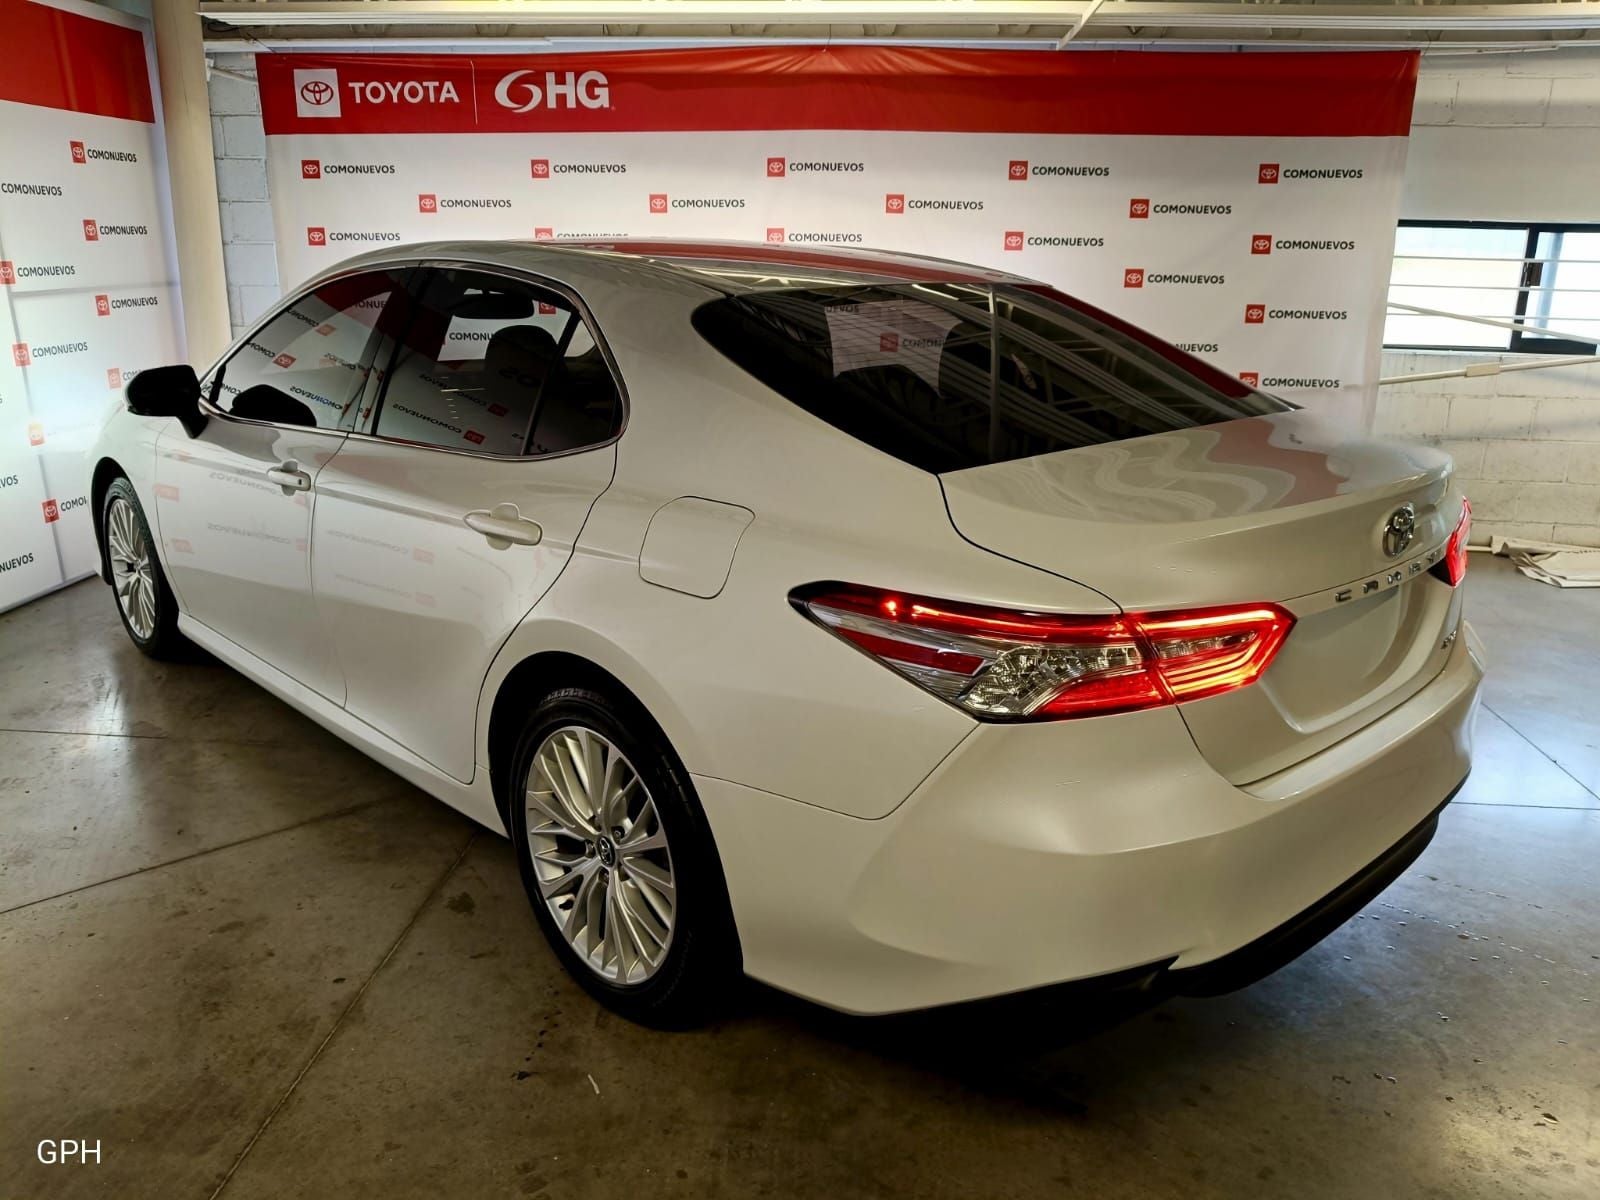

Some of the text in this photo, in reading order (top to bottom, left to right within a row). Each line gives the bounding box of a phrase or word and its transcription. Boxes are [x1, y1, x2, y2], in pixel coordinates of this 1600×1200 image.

[348, 81, 459, 104] TOYOTA
[87, 149, 137, 163] COMONUEVOS
[324, 164, 395, 174] COMONUEVOS
[553, 164, 626, 174] COMONUEVOS
[789, 162, 864, 172] COMONUEVOS
[1032, 166, 1110, 177] COMONUEVOS
[1283, 169, 1363, 179] COMONUEVOS
[1, 183, 62, 196] COMONUEVOS
[440, 199, 512, 209] COMONUEVOS
[672, 199, 745, 209] COMONUEVOS
[908, 200, 984, 210] COMONUEVOS
[1153, 204, 1232, 215] COMONUEVOS
[100, 225, 148, 235] COMONUEVOS
[329, 232, 401, 241] COMONUEVOS
[789, 233, 863, 243] COMONUEVOS
[1027, 237, 1104, 247] COMONUEVOS
[1275, 240, 1355, 250] COMONUEVOS
[17, 265, 76, 278] COMONUEVOS
[1147, 274, 1225, 284] COMONUEVOS
[111, 296, 158, 309] COMONUEVOS
[1269, 309, 1348, 320] COMONUEVOS
[449, 332, 493, 341] COMONU
[32, 341, 88, 358] COMONUEVOS
[1176, 343, 1219, 353] NUEVOS
[1262, 378, 1340, 388] COMONUEVOS
[0, 553, 34, 573] NUEVOS
